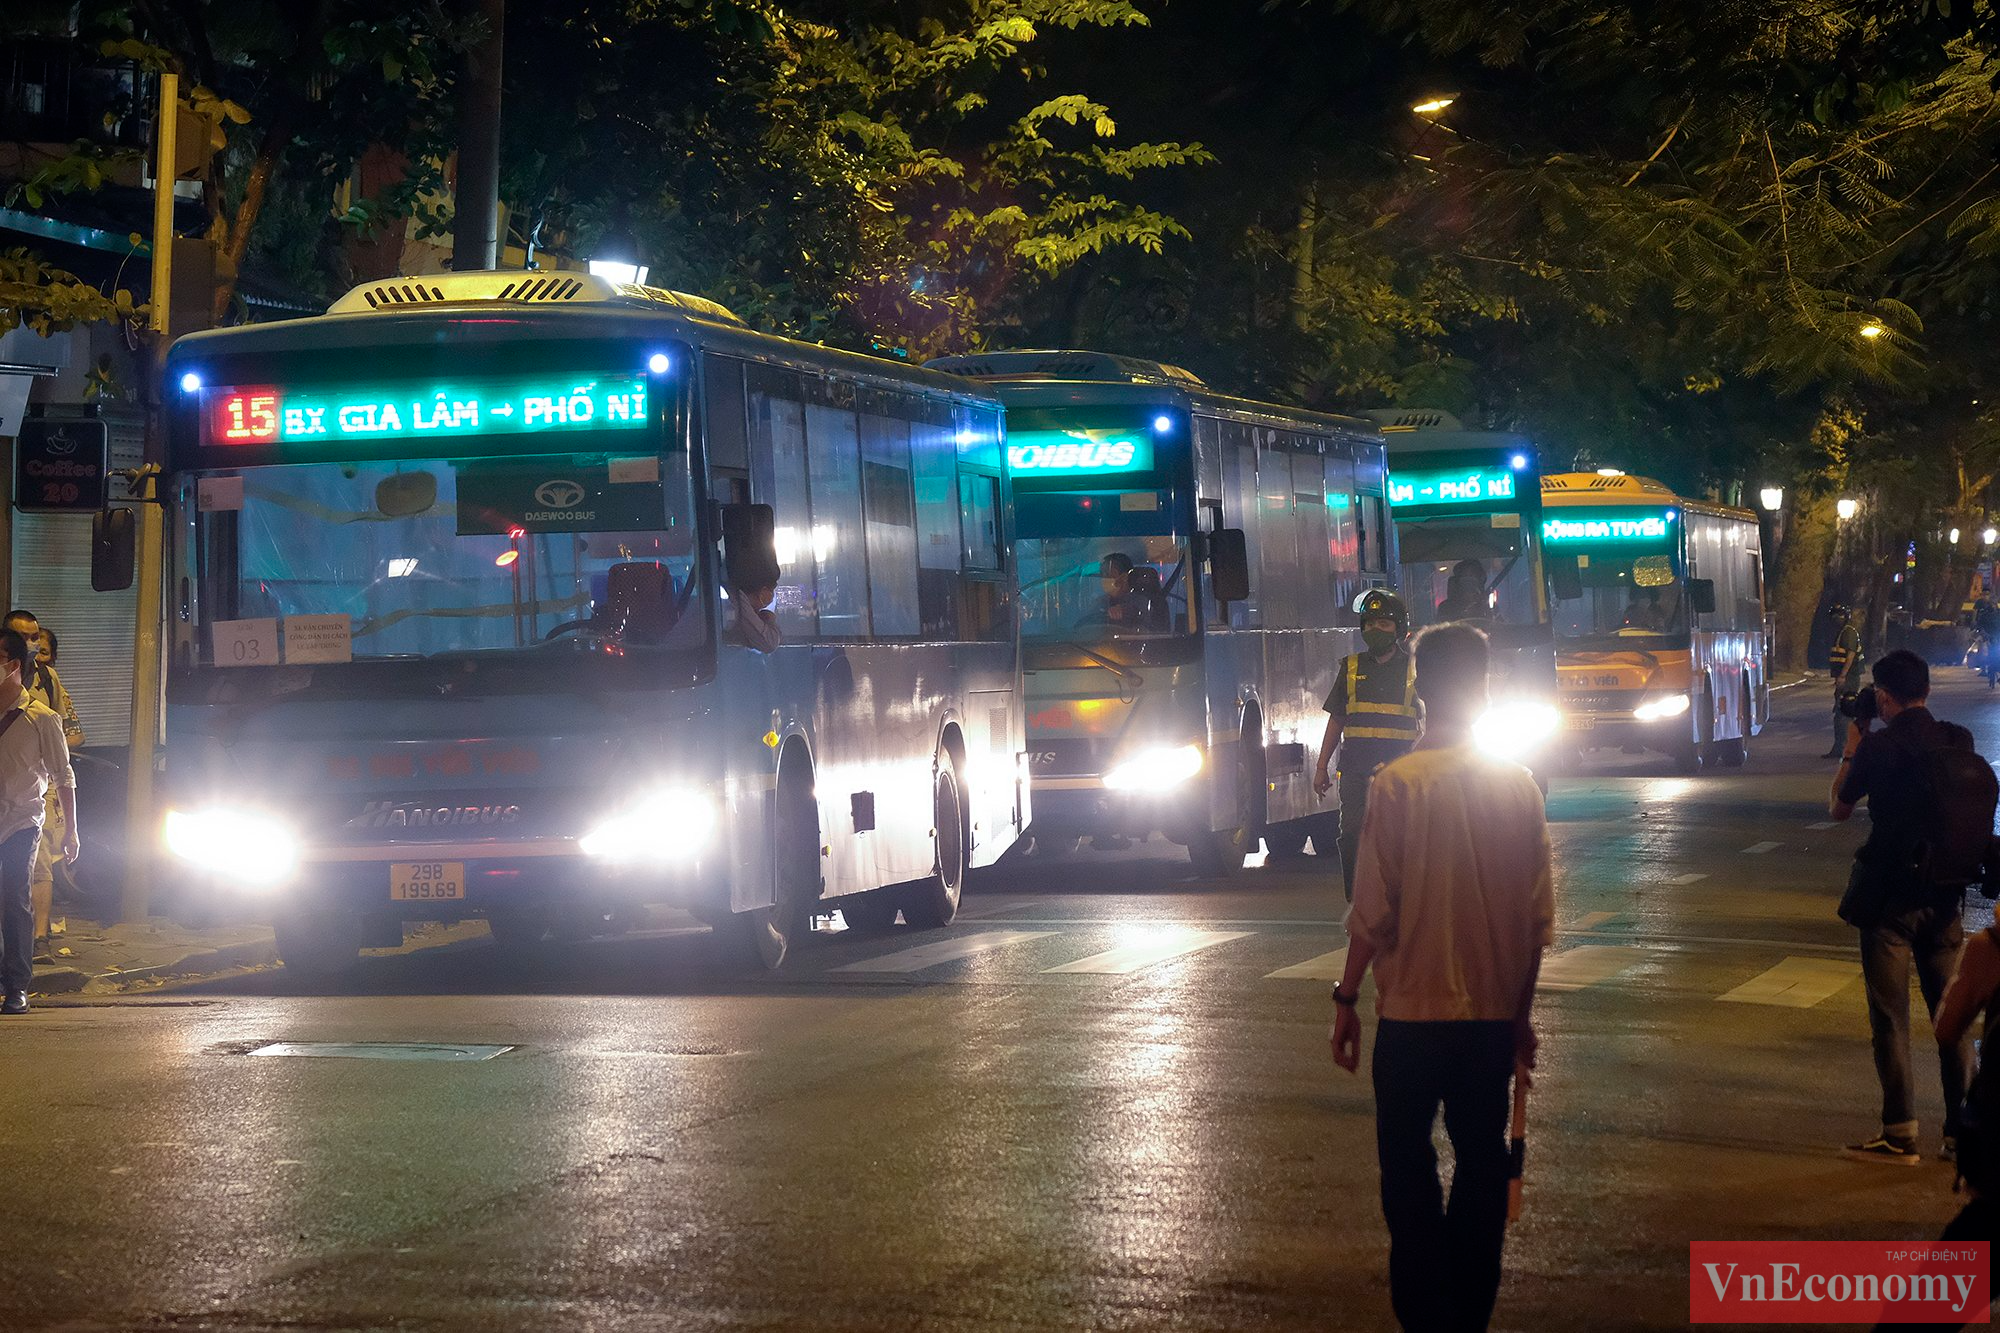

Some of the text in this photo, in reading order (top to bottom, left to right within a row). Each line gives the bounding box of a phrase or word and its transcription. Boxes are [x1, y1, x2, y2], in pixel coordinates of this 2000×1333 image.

[227, 397, 275, 437] 15
[285, 408, 326, 434] BX
[338, 404, 402, 432] GIA
[413, 392, 478, 429] LÂM
[524, 382, 597, 424] PHỐ
[26, 459, 97, 477] Coffee
[42, 482, 79, 502] 20
[525, 511, 596, 521] DAEWOO BUS
[233, 639, 260, 661] 03
[400, 882, 456, 898] 199.69
